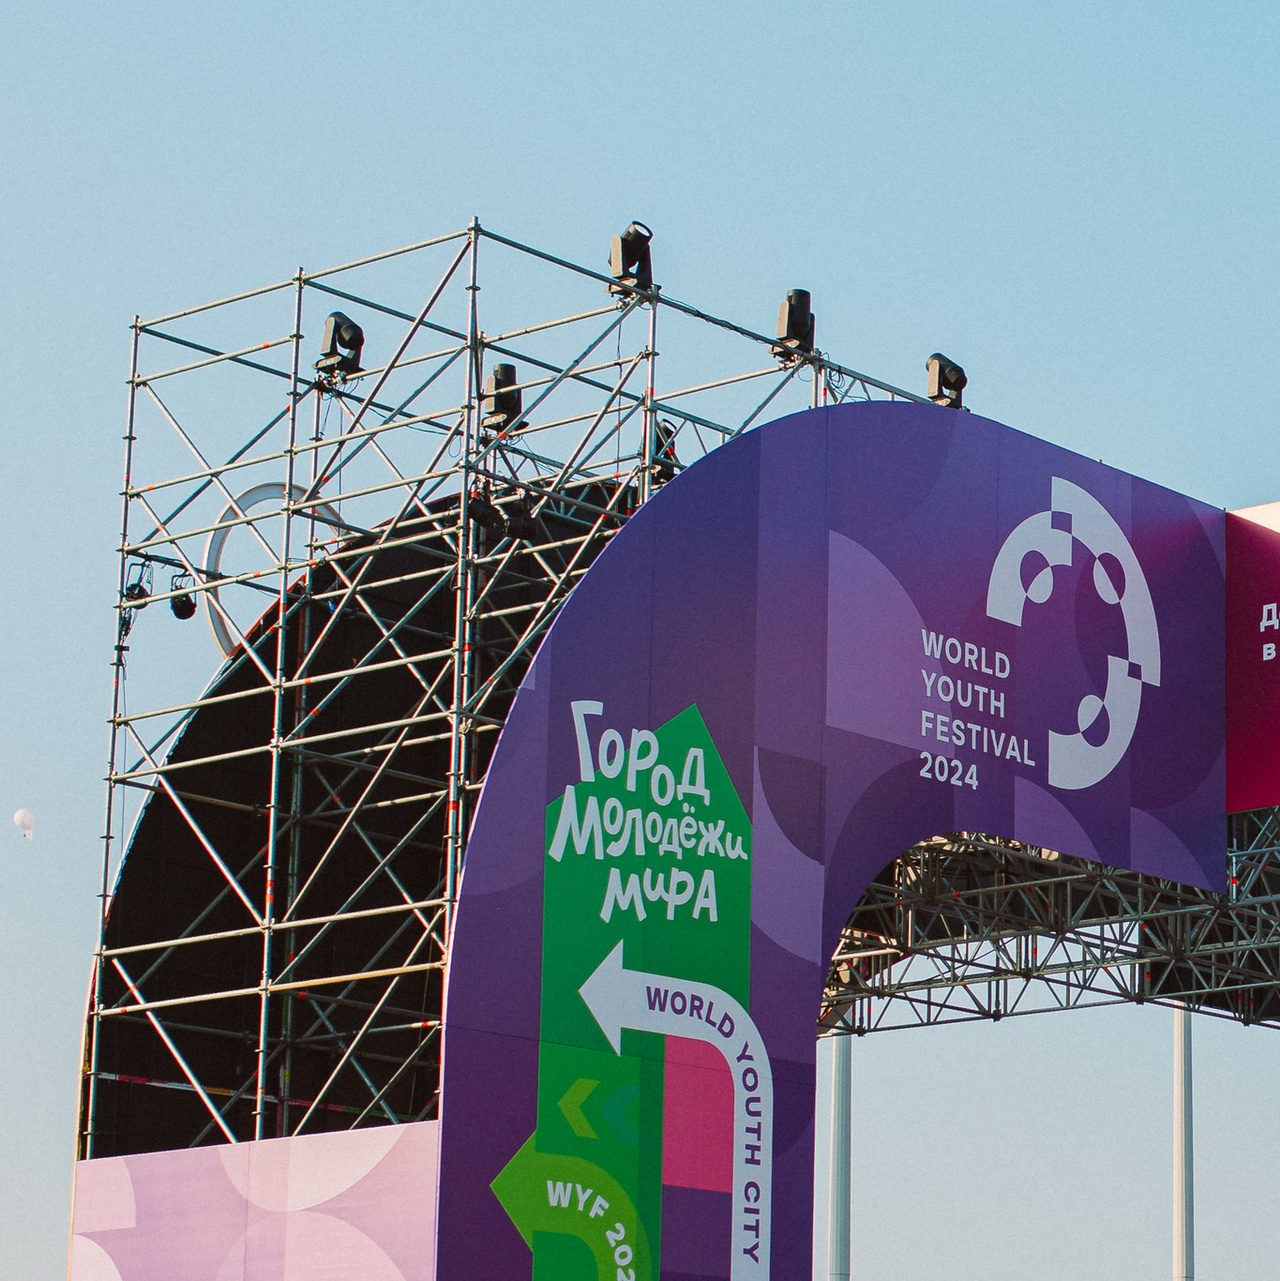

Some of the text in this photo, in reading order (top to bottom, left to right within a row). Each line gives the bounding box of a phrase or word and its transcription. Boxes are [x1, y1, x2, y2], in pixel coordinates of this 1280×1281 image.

[920, 628, 1011, 679] WORLD
[1262, 642, 1276, 662] в
[920, 668, 1006, 719] YOUTH
[920, 709, 1036, 767] FESTIVAL
[919, 751, 979, 791] 2024
[645, 985, 762, 1265] WORLD YOUTH CITY
[545, 1179, 611, 1219] WYF
